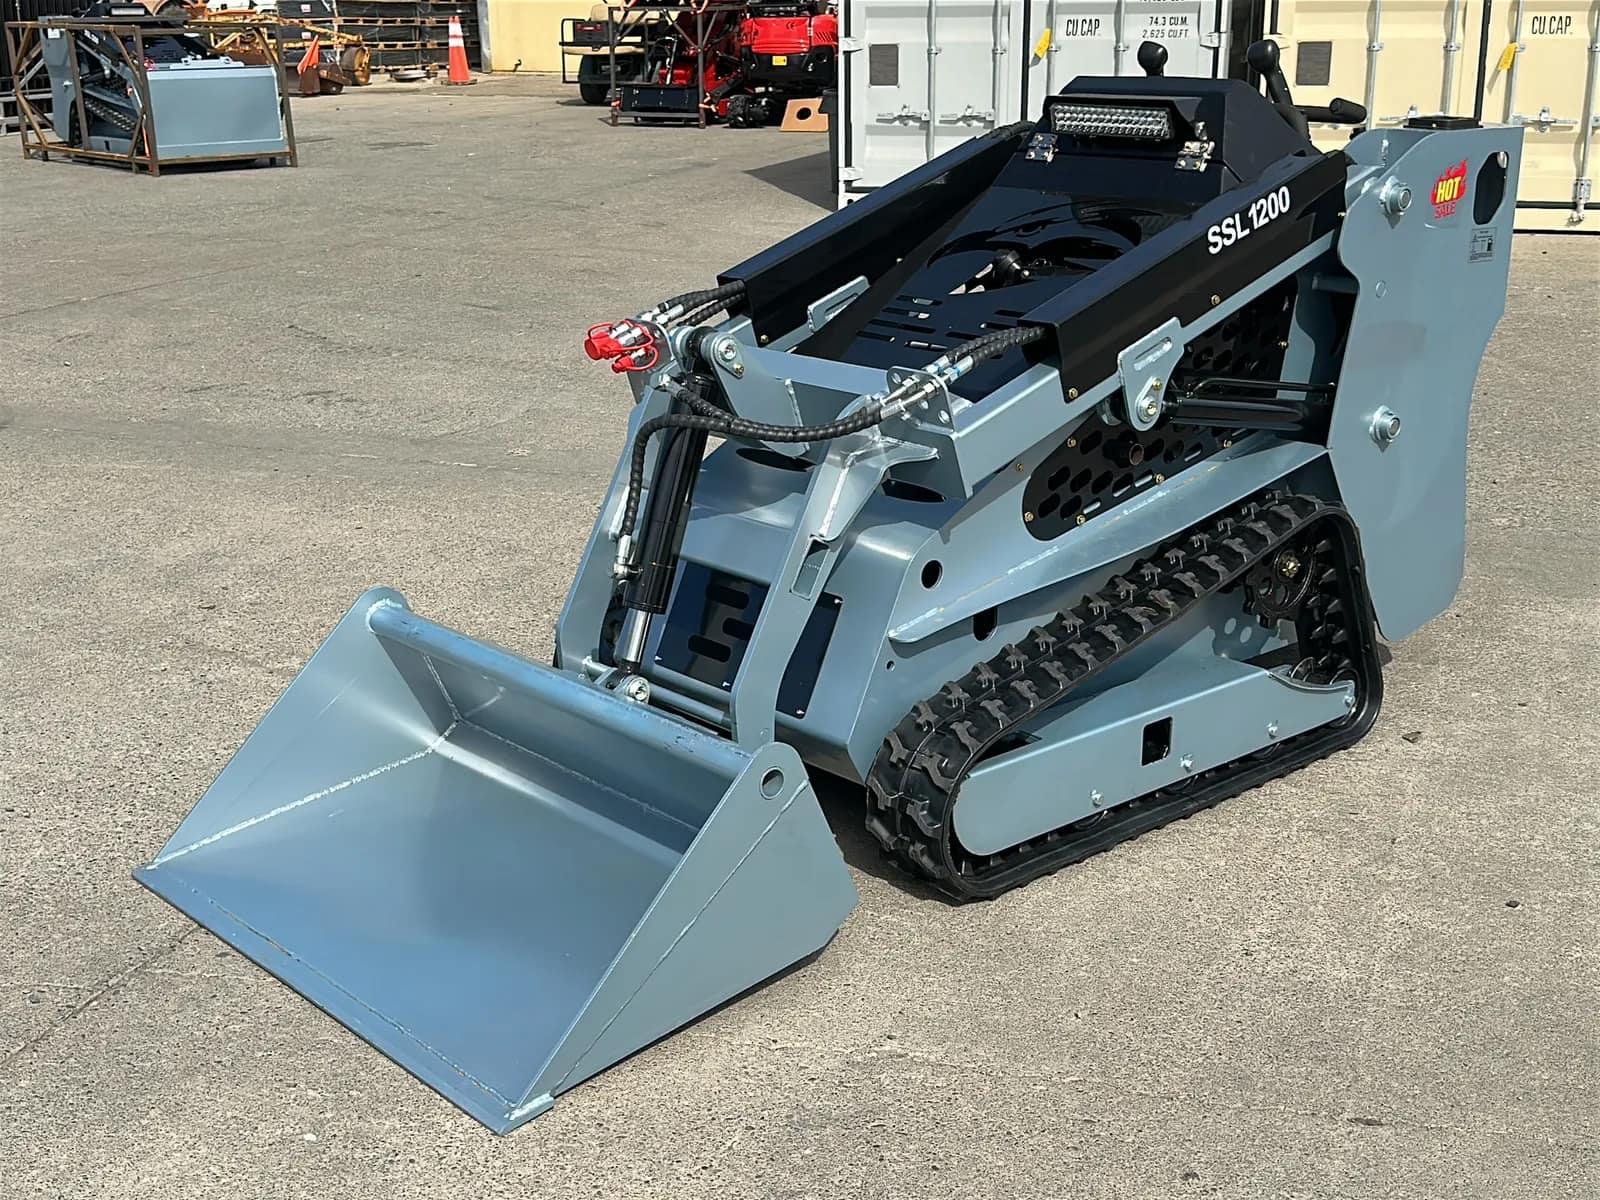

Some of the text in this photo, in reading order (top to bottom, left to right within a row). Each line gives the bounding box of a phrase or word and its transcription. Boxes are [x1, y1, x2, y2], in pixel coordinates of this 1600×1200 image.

[1149, 16, 1166, 26] 74.3
[1435, 176, 1462, 204] HOT
[1207, 185, 1290, 255] SSL 1200
